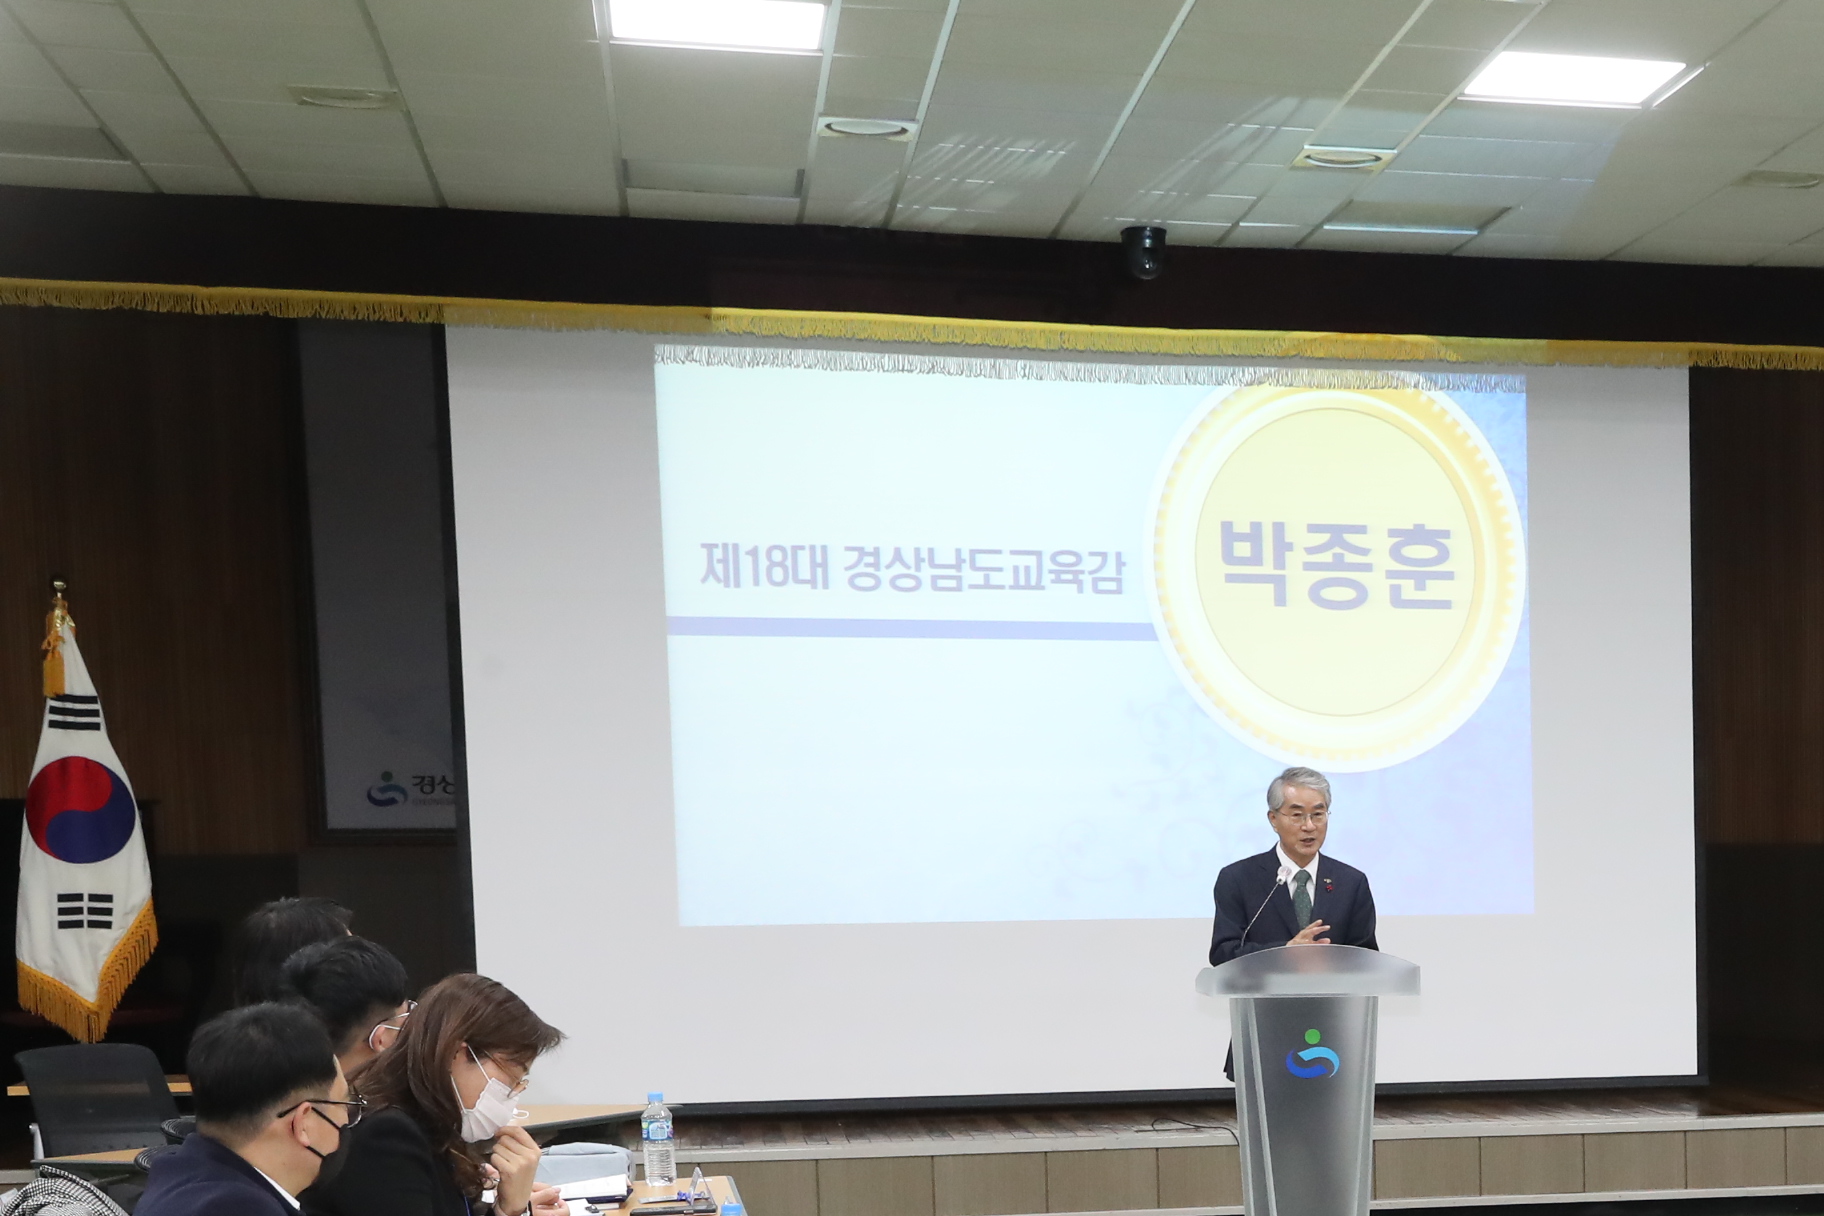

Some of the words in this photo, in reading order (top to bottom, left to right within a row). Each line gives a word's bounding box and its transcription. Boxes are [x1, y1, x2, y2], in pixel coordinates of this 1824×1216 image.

[699, 541, 830, 590] 제18대
[843, 545, 1127, 595] 경상남도교육감
[1220, 520, 1456, 611] 박종훈
